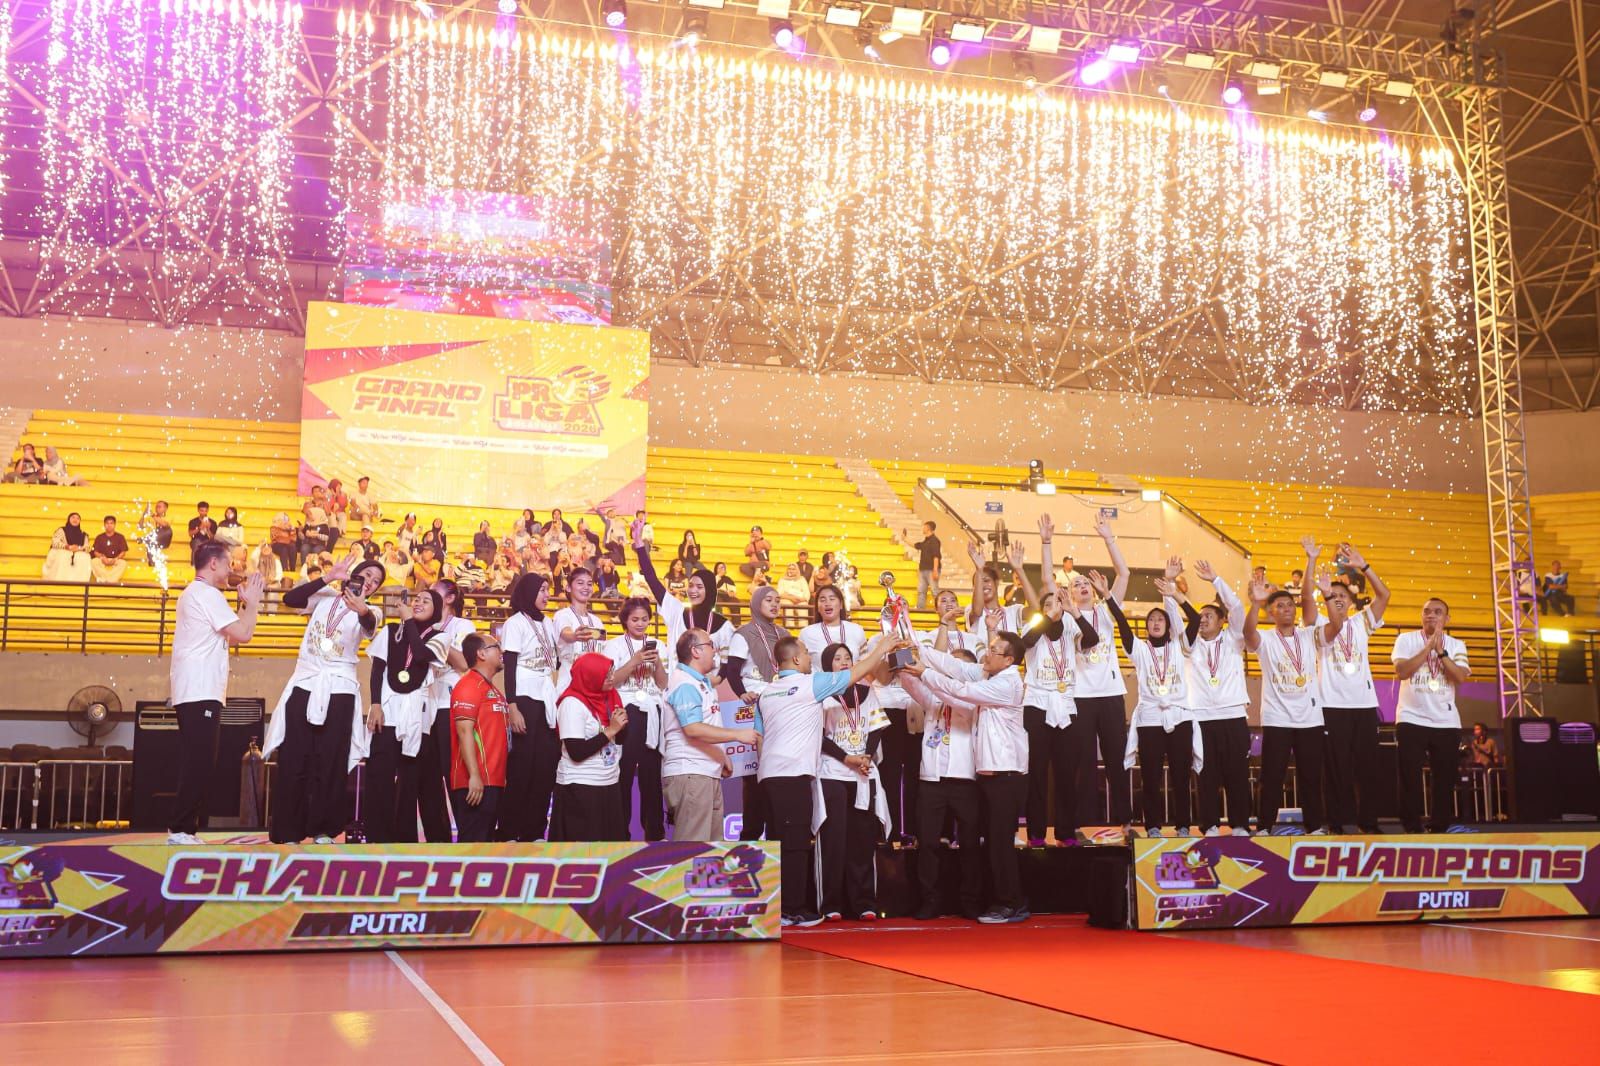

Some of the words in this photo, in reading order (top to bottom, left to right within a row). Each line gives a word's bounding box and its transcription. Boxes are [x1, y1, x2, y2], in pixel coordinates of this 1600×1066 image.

[355, 377, 483, 401] GRAND
[353, 395, 455, 417] FINAL
[499, 400, 594, 424] LIGA
[1293, 845, 1583, 879] CHAMPIONS
[166, 857, 603, 899] CHAMPIONS
[1418, 891, 1470, 908] PUTRI
[349, 913, 427, 934] PUTRI
